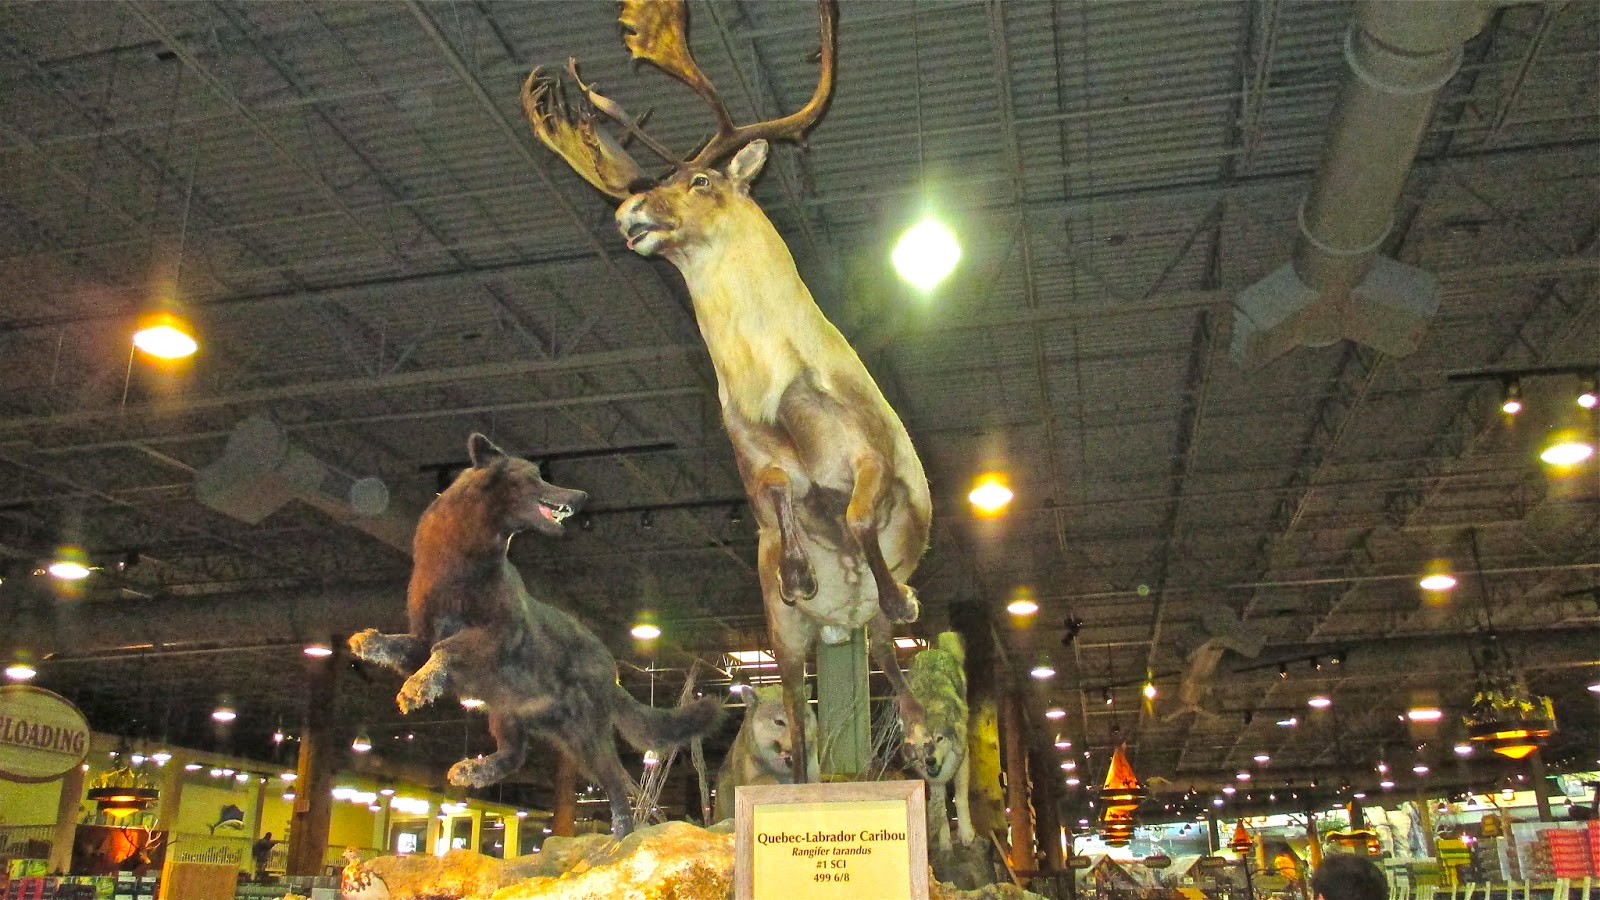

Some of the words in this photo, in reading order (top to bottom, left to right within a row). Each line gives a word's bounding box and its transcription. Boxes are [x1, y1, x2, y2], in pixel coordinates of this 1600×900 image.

[757, 831, 856, 845] Quebec-Labrador
[859, 830, 906, 842] Caribou
[792, 847, 830, 858] Rangifer
[832, 846, 872, 855] tarandus
[816, 860, 827, 869] #1
[830, 860, 847, 869] SCI
[814, 873, 831, 882] 499
[834, 873, 850, 882] 6/8
